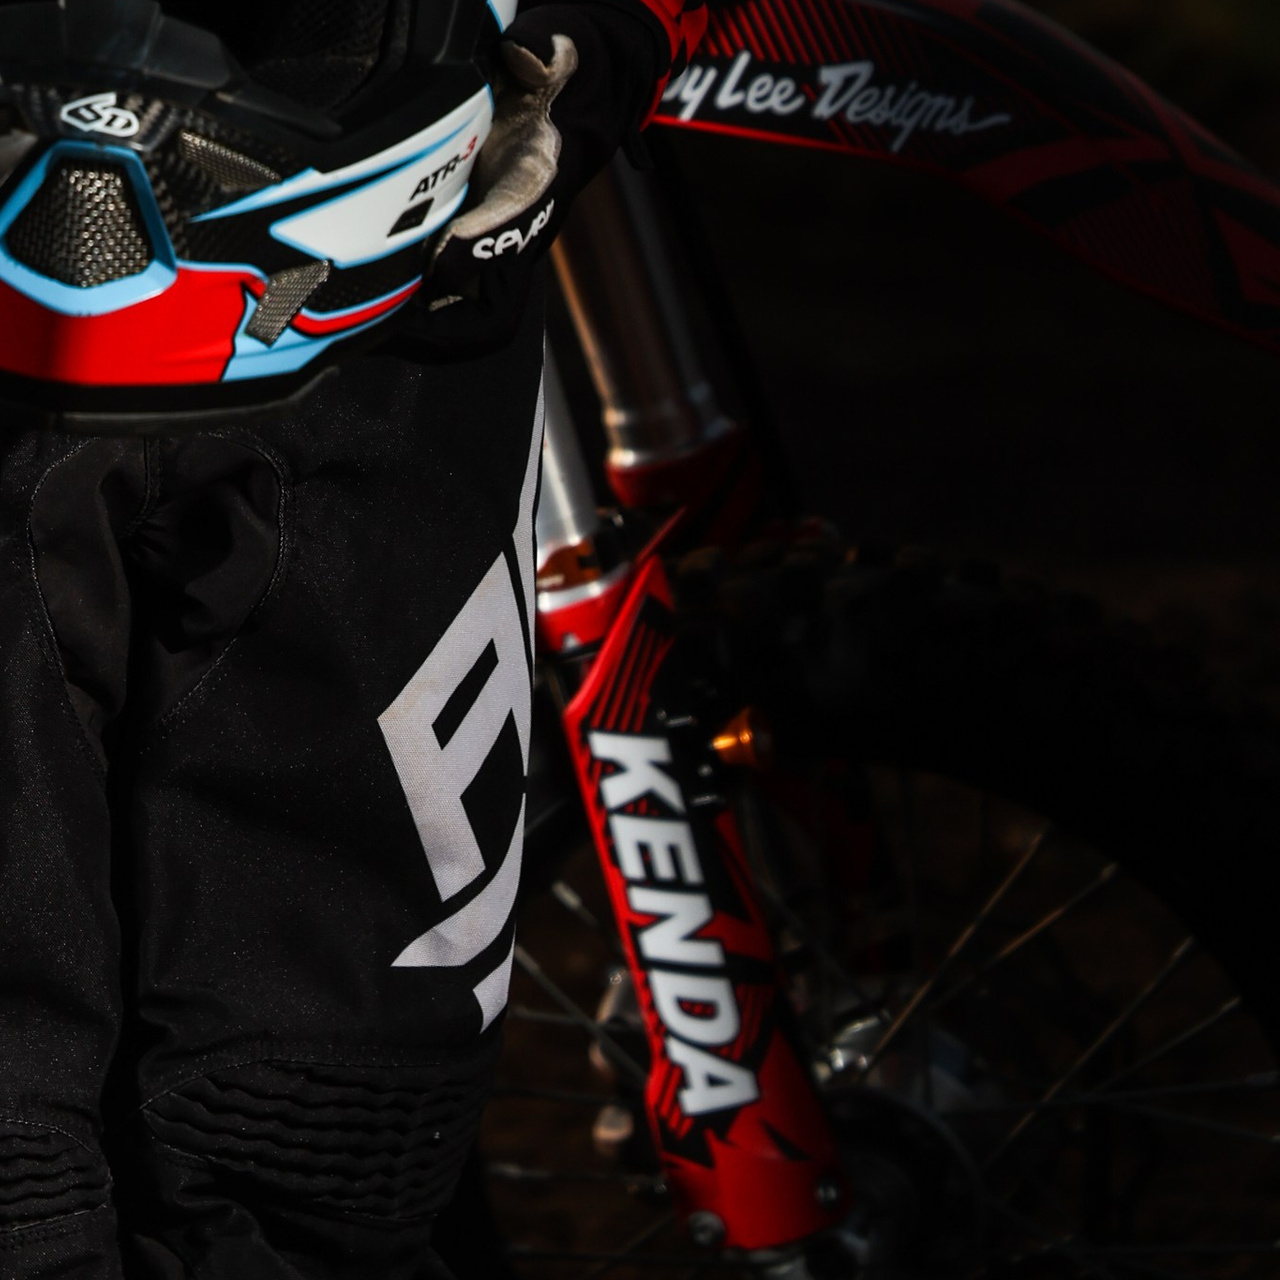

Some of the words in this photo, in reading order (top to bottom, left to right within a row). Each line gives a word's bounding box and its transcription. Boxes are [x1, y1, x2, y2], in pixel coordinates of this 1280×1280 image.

[714, 49, 807, 115] Lee
[810, 59, 1013, 154] Designs
[409, 135, 478, 202] ATR-3
[588, 729, 762, 1117] KENDA
